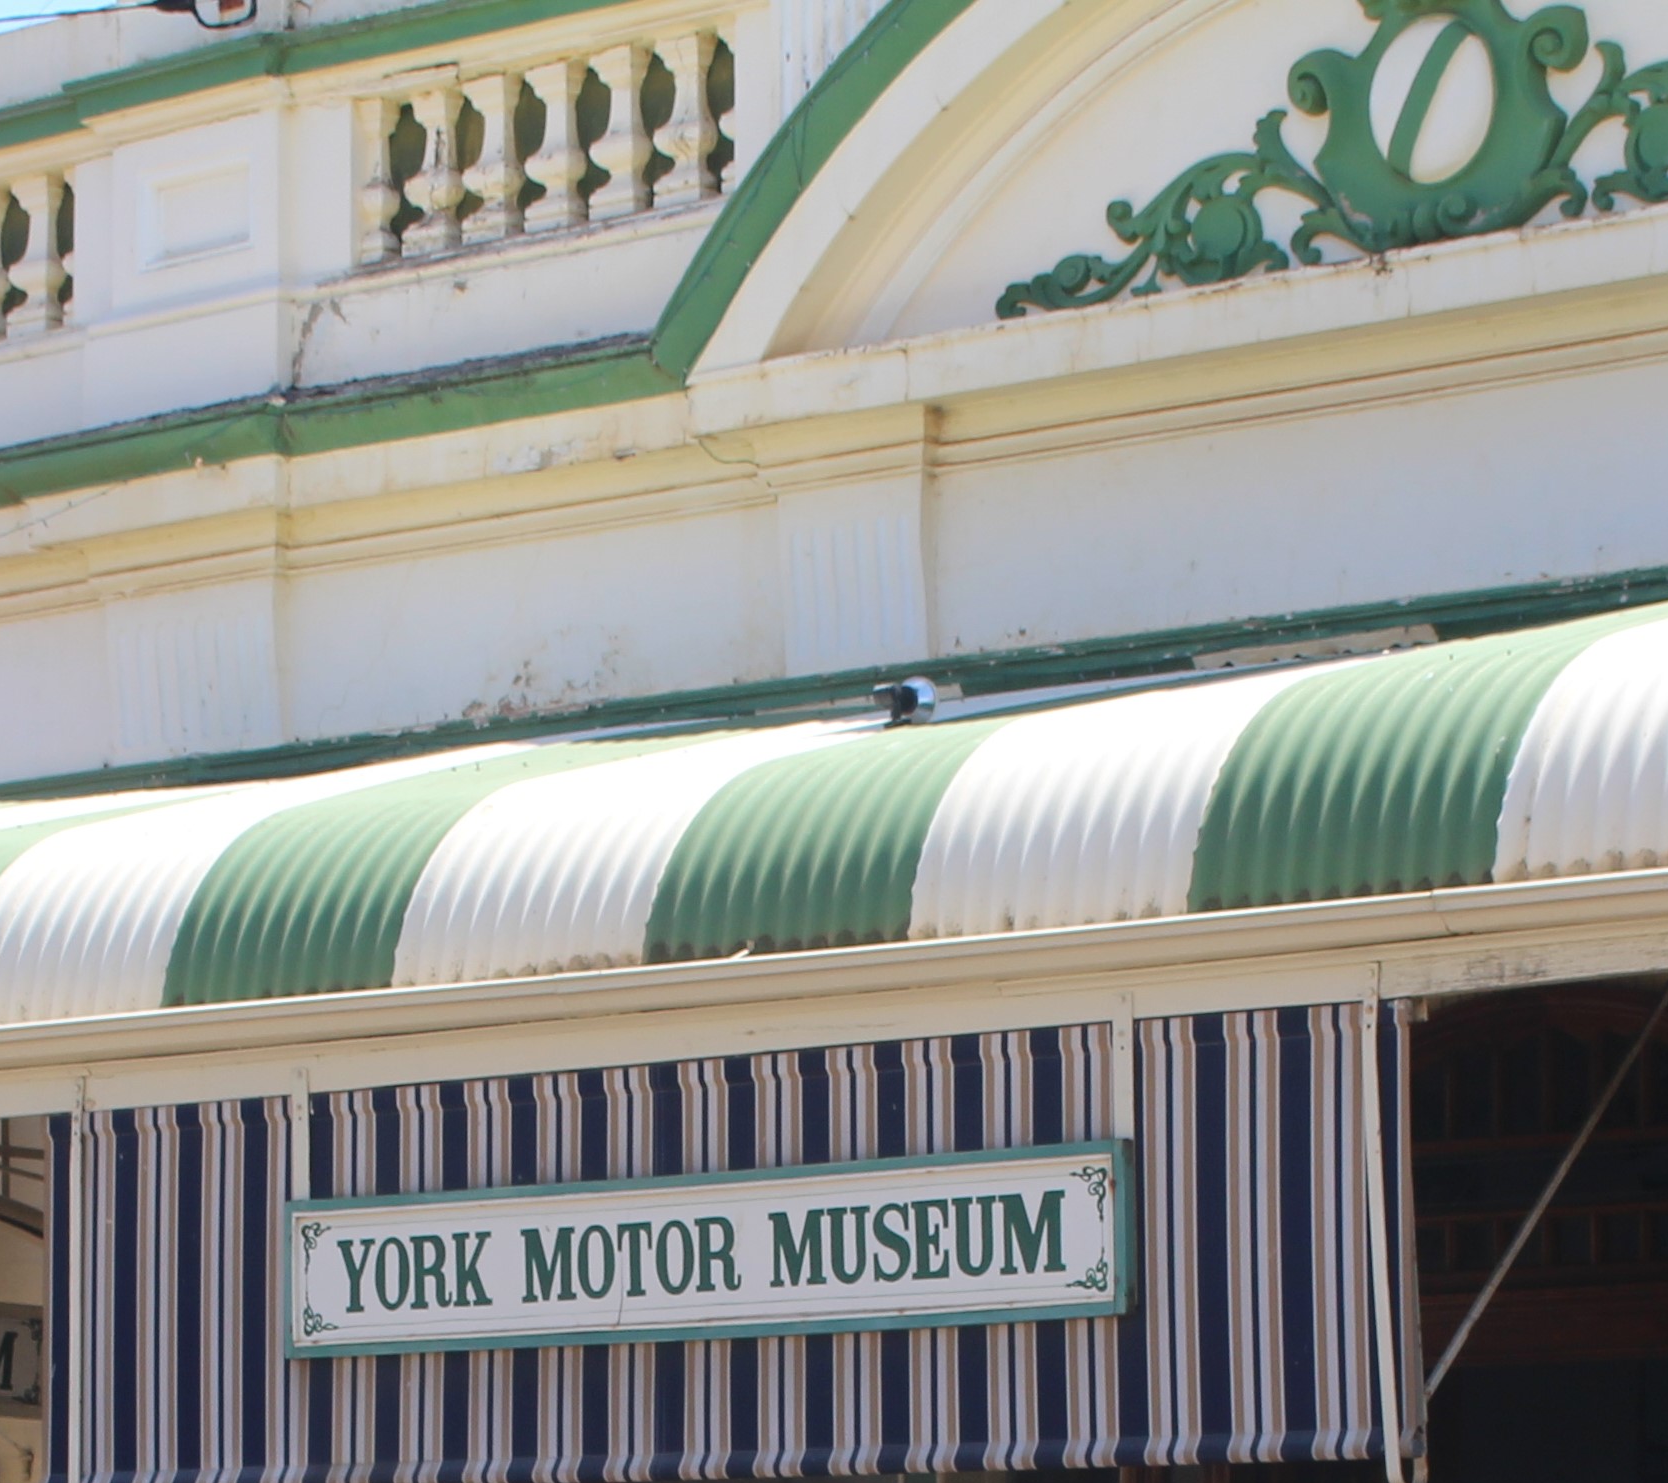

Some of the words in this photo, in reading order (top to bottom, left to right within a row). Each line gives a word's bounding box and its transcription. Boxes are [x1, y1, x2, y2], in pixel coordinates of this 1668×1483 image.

[337, 1230, 493, 1312] YORK
[521, 1216, 741, 1303] MOTOR
[769, 1190, 1067, 1288] MUSEUM
